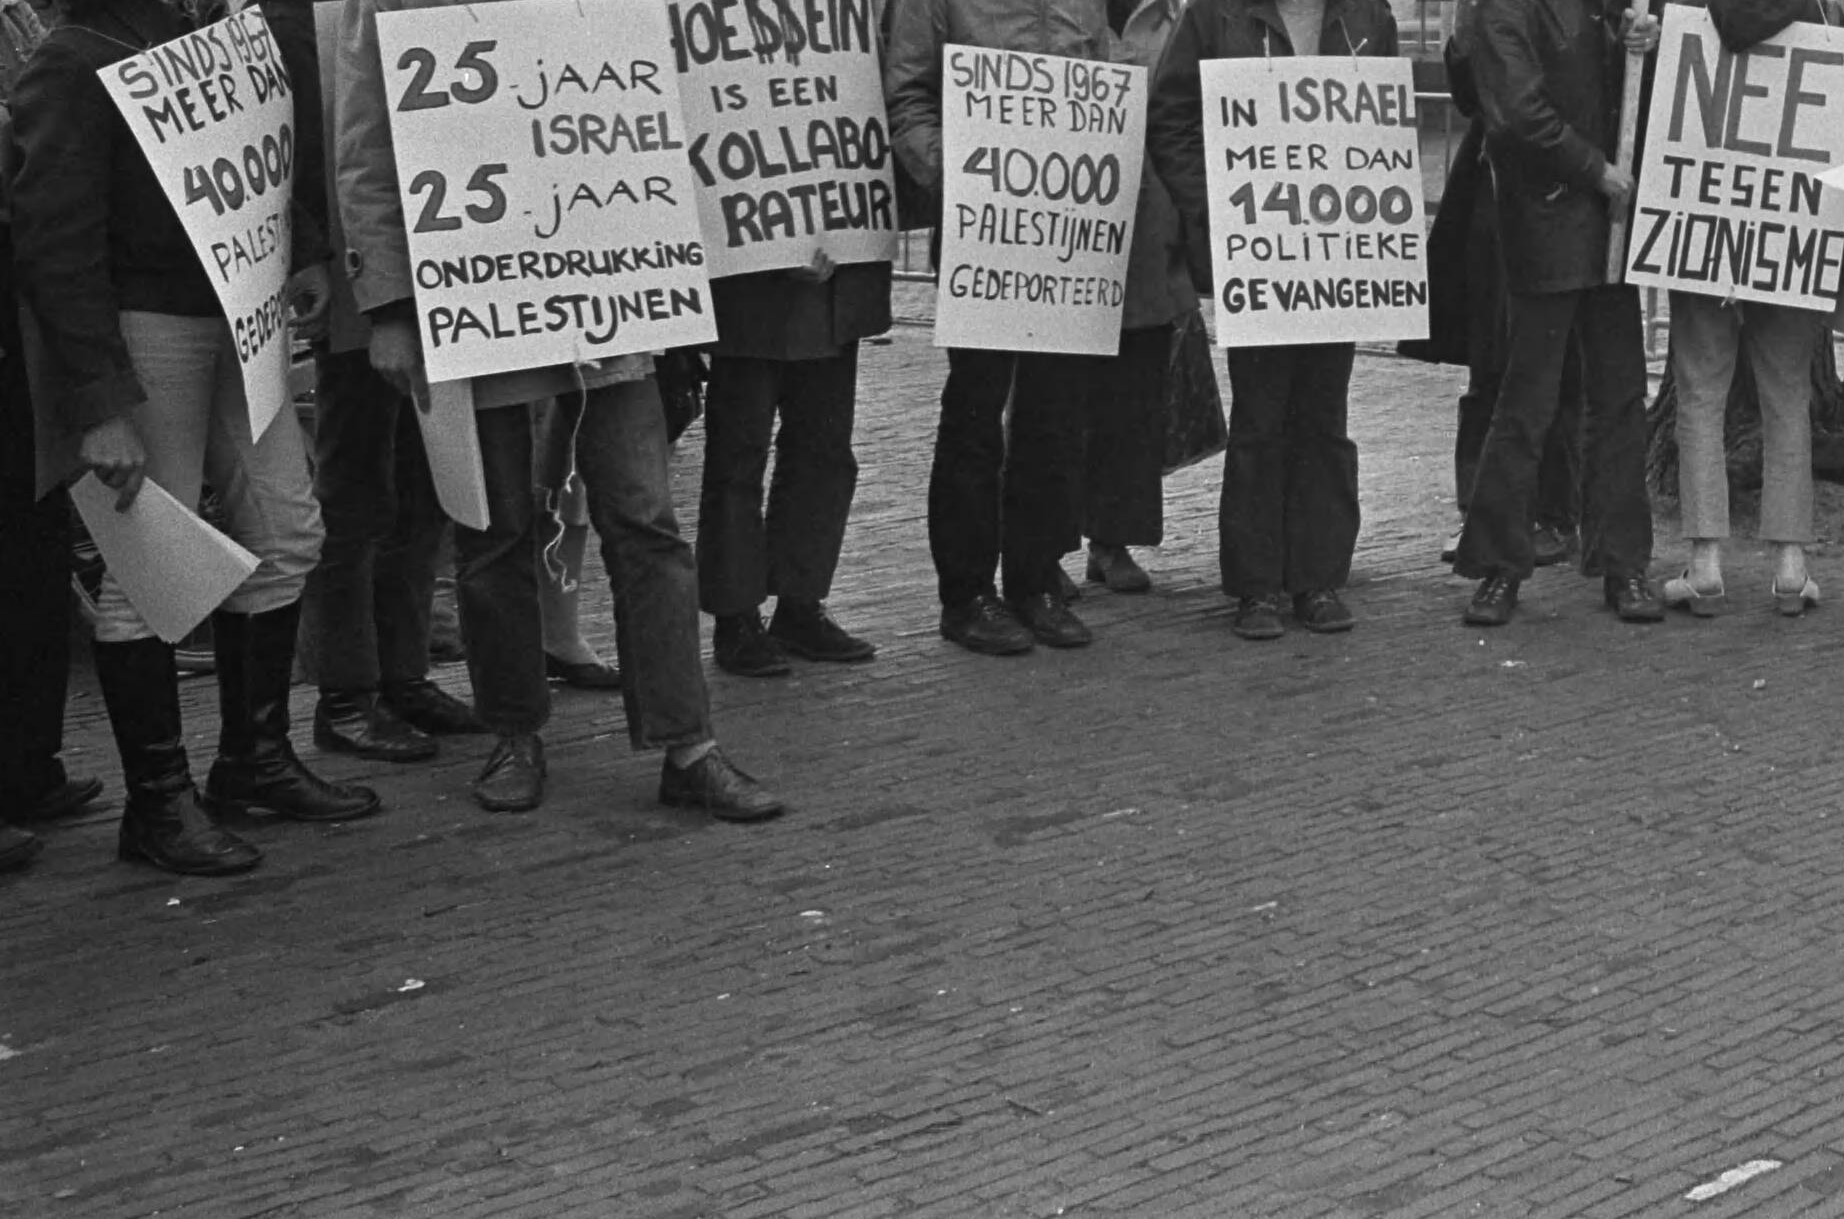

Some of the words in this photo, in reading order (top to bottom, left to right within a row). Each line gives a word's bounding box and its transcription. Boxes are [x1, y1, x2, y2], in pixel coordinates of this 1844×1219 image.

[118, 26, 233, 100] SINDS
[397, 40, 499, 112] 25
[951, 52, 1055, 94] SINDS
[1064, 60, 1132, 108] 1967
[142, 74, 244, 144] MEER
[711, 84, 748, 113] IS
[768, 75, 838, 107] EEN
[966, 91, 1057, 128] MEER
[1067, 100, 1127, 135] DAN
[1221, 96, 1257, 127] IN
[1278, 76, 1417, 127] ISRAEL
[1667, 32, 1844, 163] NEE
[531, 111, 683, 158] ISRAEL
[1226, 143, 1328, 171] MEER
[1346, 146, 1412, 171] DAN
[184, 123, 292, 216] 40.000
[409, 163, 508, 233] 25
[963, 146, 1120, 206] 40.000
[721, 179, 892, 248] RATEUR
[1229, 181, 1413, 225] 14.000
[950, 264, 1123, 307] GEDEPORTEERD
[1222, 277, 1427, 314] GEVANGENEN
[428, 287, 703, 348] PALESTIJNEN
